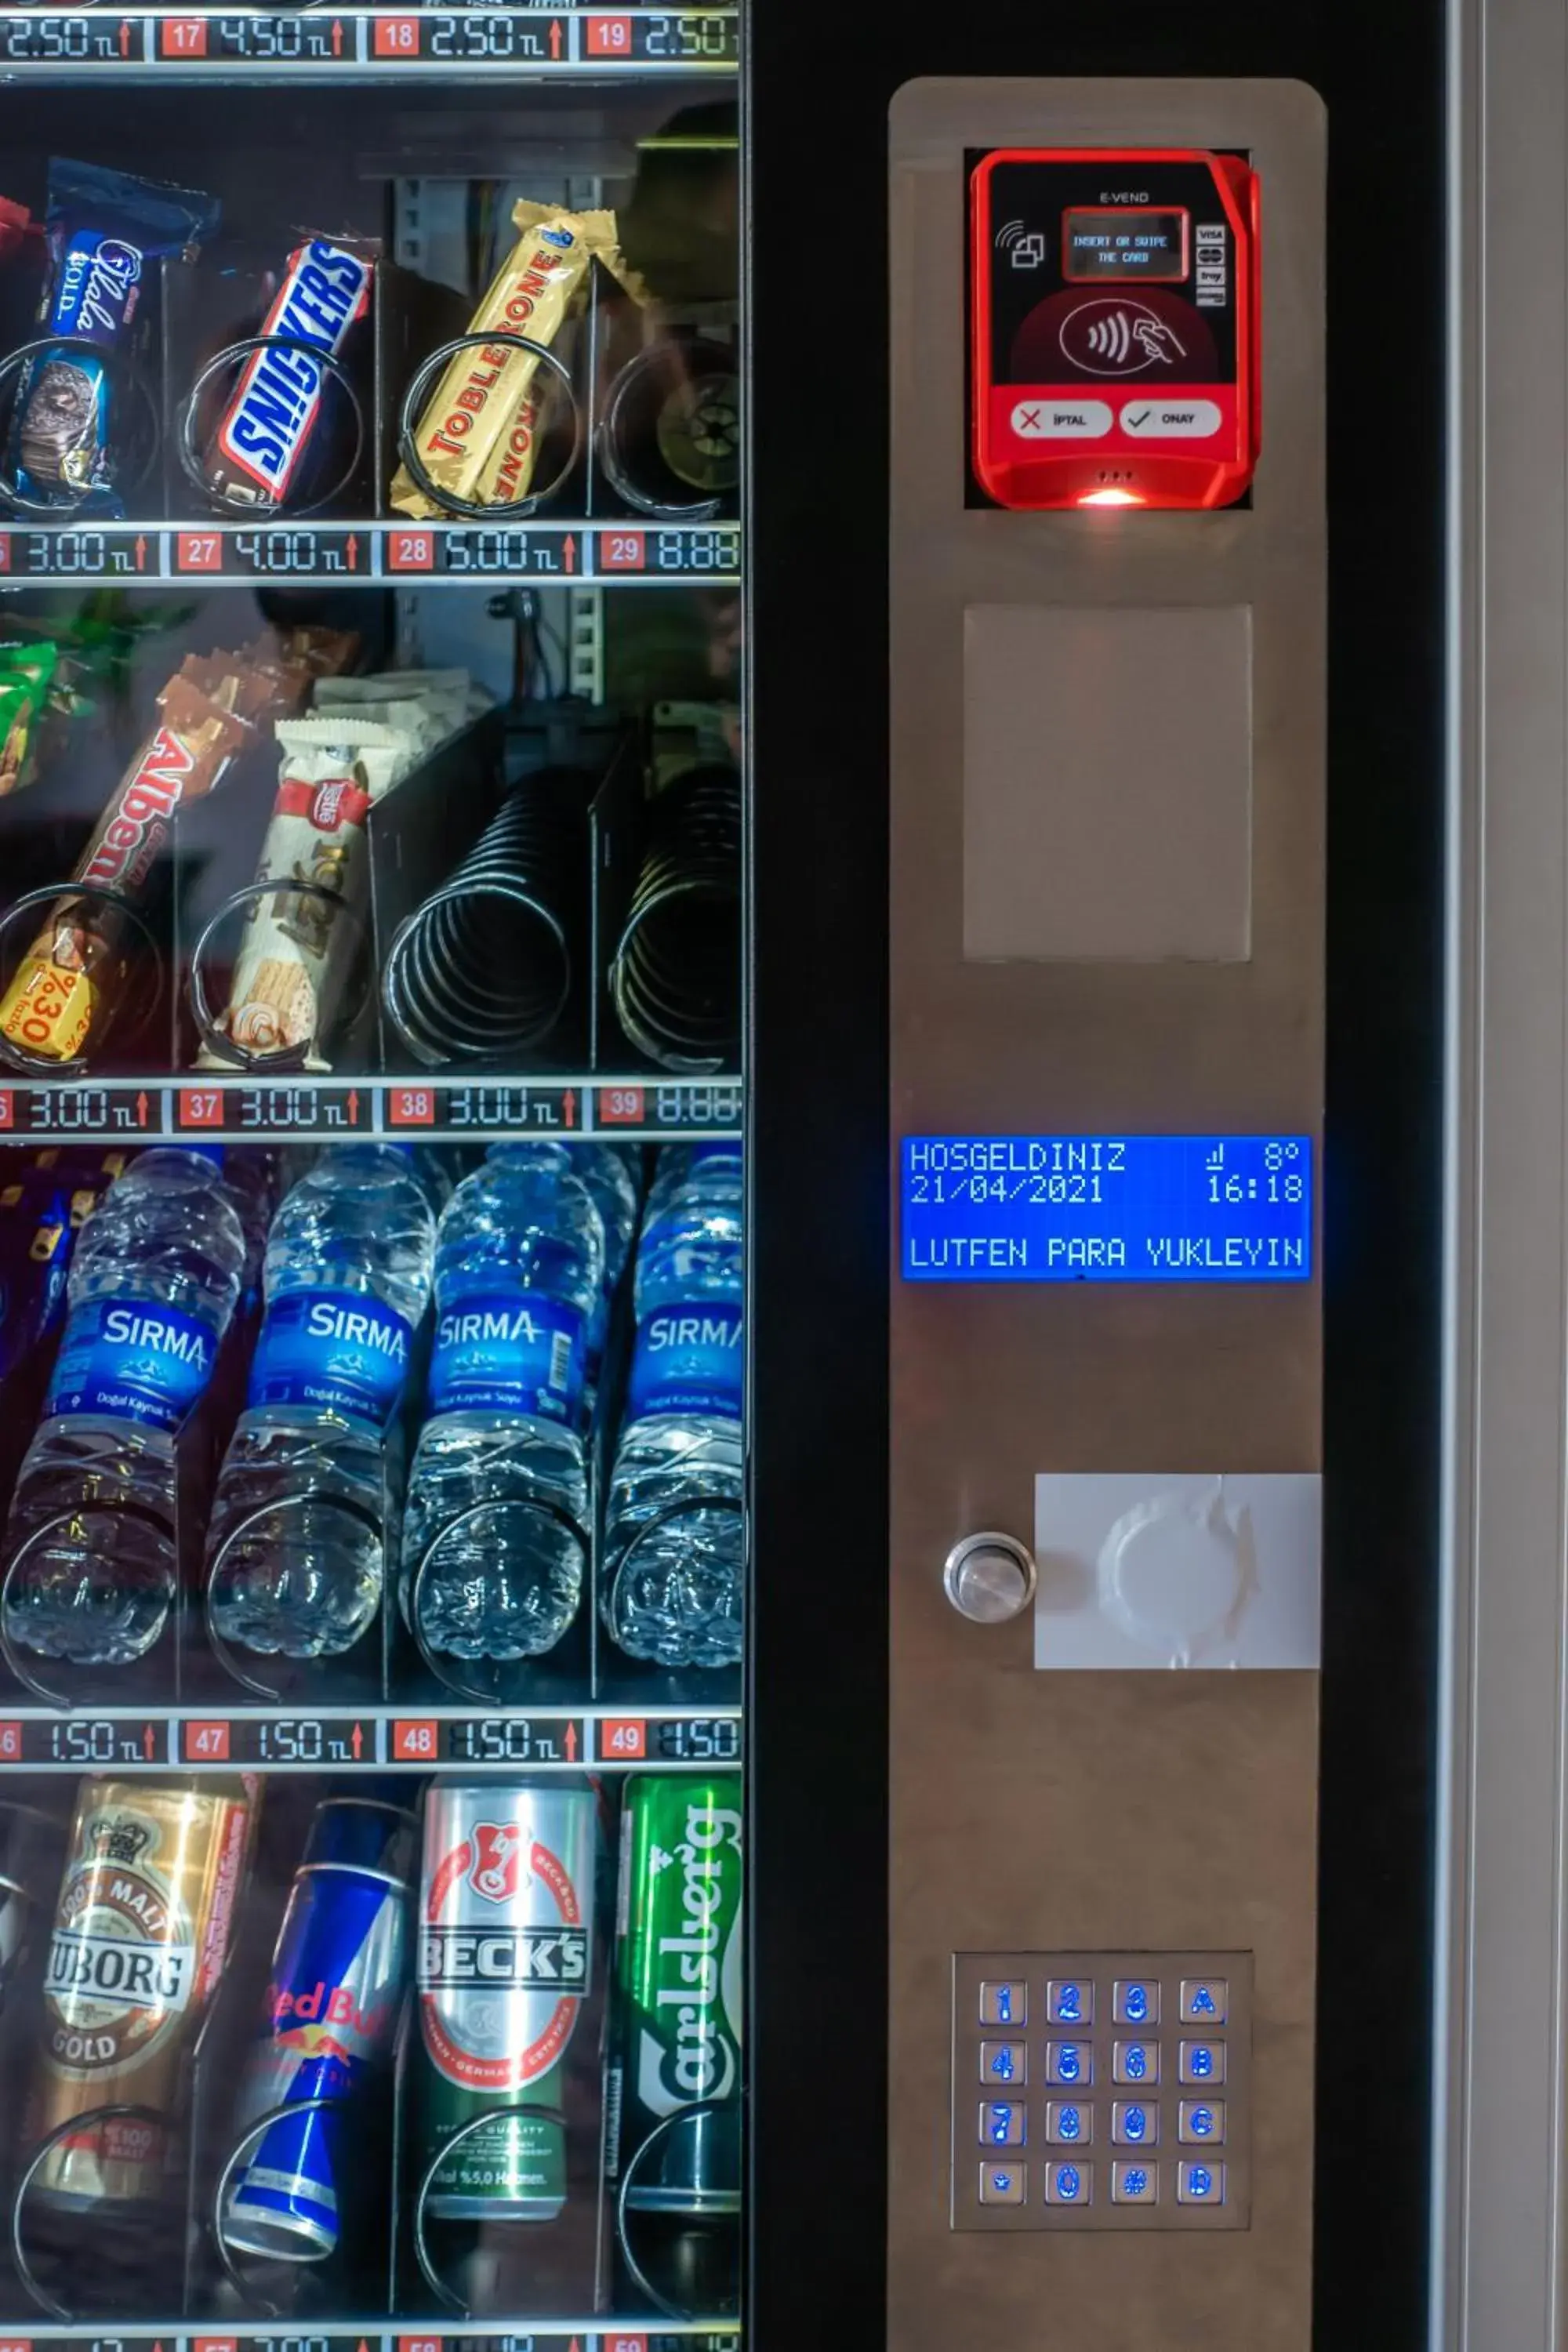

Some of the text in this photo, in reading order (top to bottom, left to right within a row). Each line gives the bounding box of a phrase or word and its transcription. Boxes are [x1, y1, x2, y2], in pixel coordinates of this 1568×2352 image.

[8, 18, 88, 56] 2.50
[172, 24, 201, 48] 17
[220, 18, 301, 56] 4.50
[385, 24, 413, 47] 18
[432, 16, 514, 55] 2.50
[598, 23, 626, 46] 19
[645, 16, 726, 54] 2.50
[1100, 192, 1149, 203] E-VEND
[1073, 236, 1167, 247] INSERT OR SWIPE
[1200, 230, 1223, 239] VISA
[1098, 252, 1149, 263] THE CARD
[232, 241, 363, 475] SNICKERS
[1054, 413, 1087, 426] İPTAL
[1162, 413, 1195, 424] ONAY
[29, 533, 105, 571] 3.00
[188, 539, 216, 564] 27
[237, 532, 315, 570] 4.00
[399, 539, 427, 561] 28
[446, 532, 528, 569] 5.00
[611, 539, 639, 561] 29
[659, 532, 739, 569] 8.88
[22, 971, 76, 1044] %30
[31, 1090, 107, 1127] 3.00
[190, 1095, 217, 1118] 37
[241, 1089, 317, 1127] 3.00
[401, 1093, 428, 1116] 38
[450, 1087, 527, 1124] 3.00
[611, 1091, 638, 1115] 39
[911, 1142, 1125, 1171] HOSGELDINIZ
[911, 1175, 1102, 1203] 21/04/2021
[1209, 1174, 1301, 1203] 16:18
[911, 1238, 1301, 1266] LUTFEN PARA YUKLEYIN
[103, 1308, 208, 1373] SIRMA
[307, 1302, 408, 1364] SIRMA
[438, 1310, 546, 1349] SIRMA
[0, 1730, 16, 1754] 6
[53, 1722, 114, 1760] 1.50
[196, 1730, 222, 1753] 47
[260, 1722, 321, 1759] 1.50
[403, 1728, 431, 1751] 48
[466, 1720, 530, 1759] 1.50
[612, 1727, 639, 1750] 49
[673, 1720, 737, 1757] 1.50
[110, 1879, 168, 1933] MALT
[52, 1942, 183, 1998] UBORG
[420, 1932, 585, 1980] BECK'S
[638, 1804, 742, 2117] Carlsberg
[325, 1987, 384, 2036] Bu
[997, 1986, 1011, 2021] 1
[1058, 1985, 1081, 2021] 2
[1127, 1985, 1147, 2020] 3
[1191, 1987, 1215, 2014] A
[53, 2030, 116, 2062] GOLD
[991, 2046, 1014, 2080] 4
[1058, 2044, 1080, 2080] 5
[1127, 2045, 1146, 2078] 6
[1191, 2048, 1212, 2077] B
[992, 2103, 1011, 2143] 7
[1059, 2107, 1080, 2140] 8
[1191, 2107, 1214, 2136] C
[495, 2171, 547, 2185] Hmen.
[1057, 2165, 1080, 2199] 0
[1190, 2167, 1212, 2195] D
